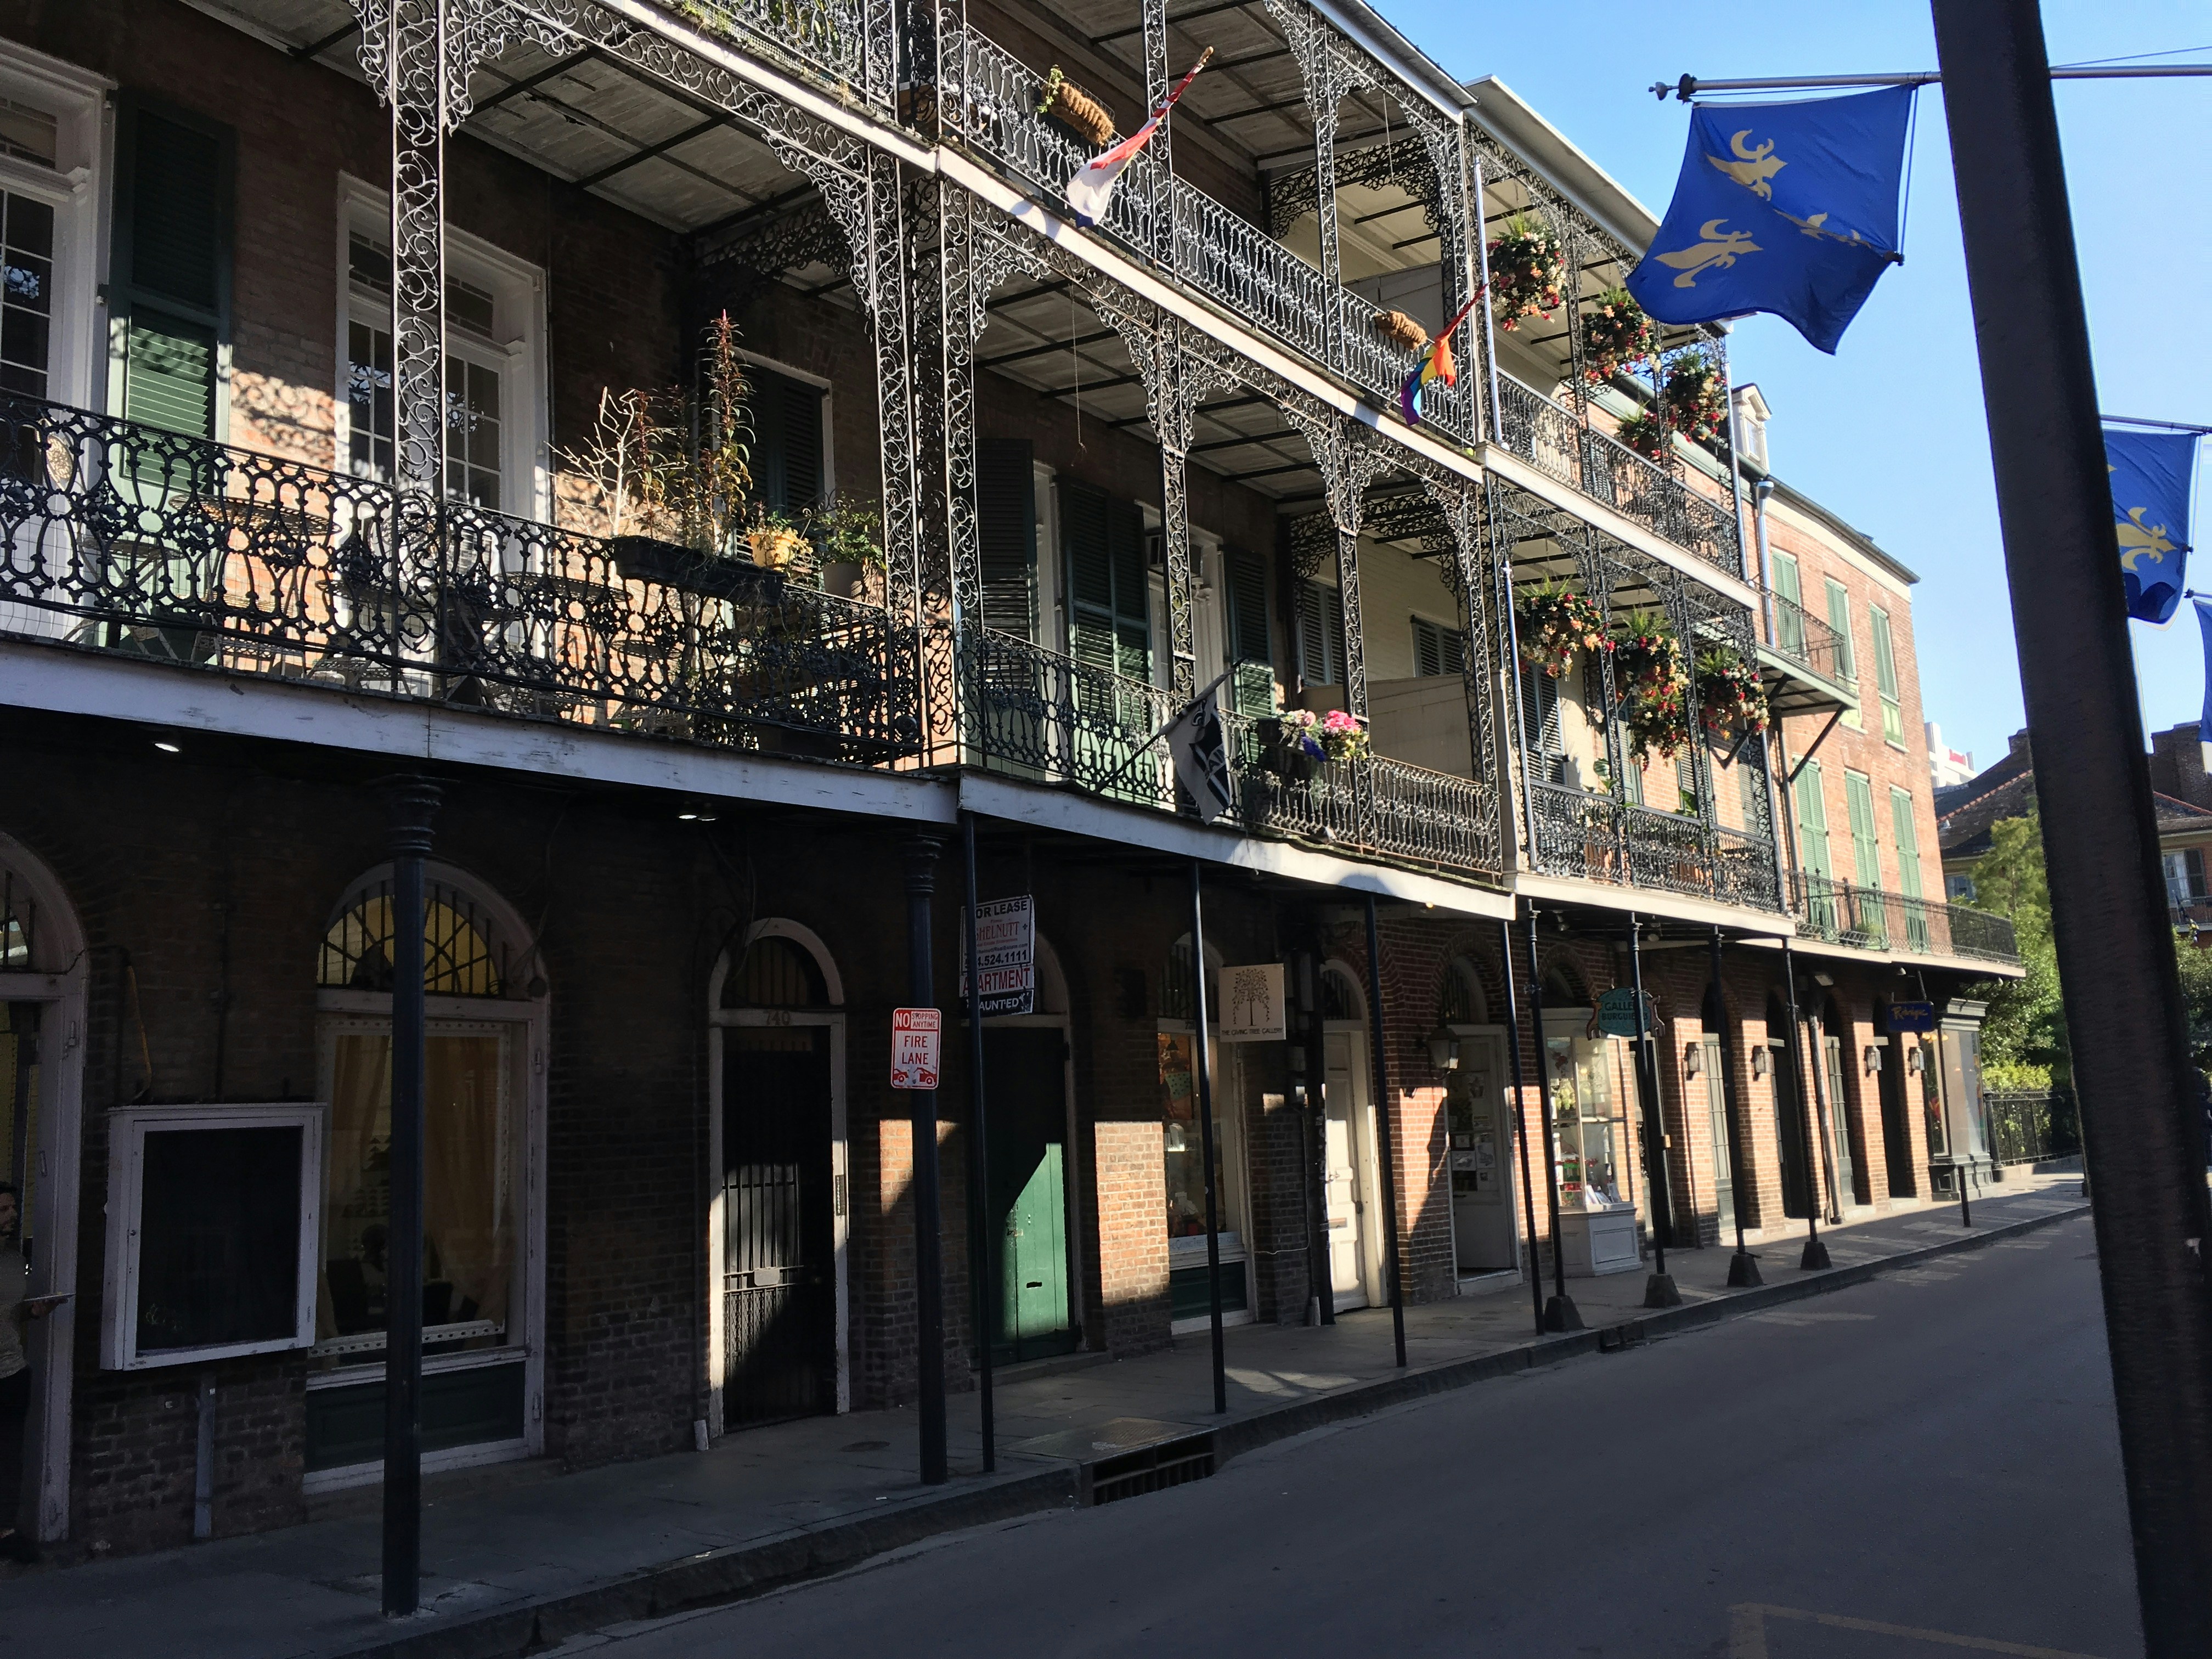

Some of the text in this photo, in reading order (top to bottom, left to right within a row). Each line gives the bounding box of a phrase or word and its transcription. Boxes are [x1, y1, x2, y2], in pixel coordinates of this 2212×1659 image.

[976, 900, 1028, 919] OR LEASE
[966, 950, 1027, 968] 4.524.1111
[963, 968, 1030, 994] AARTMENT
[979, 998, 1019, 1011] AUNTED
[1605, 1002, 1634, 1011] GALLE
[895, 1012, 911, 1028] NO
[905, 1036, 928, 1048] FIRE
[902, 1052, 929, 1065] LANE
